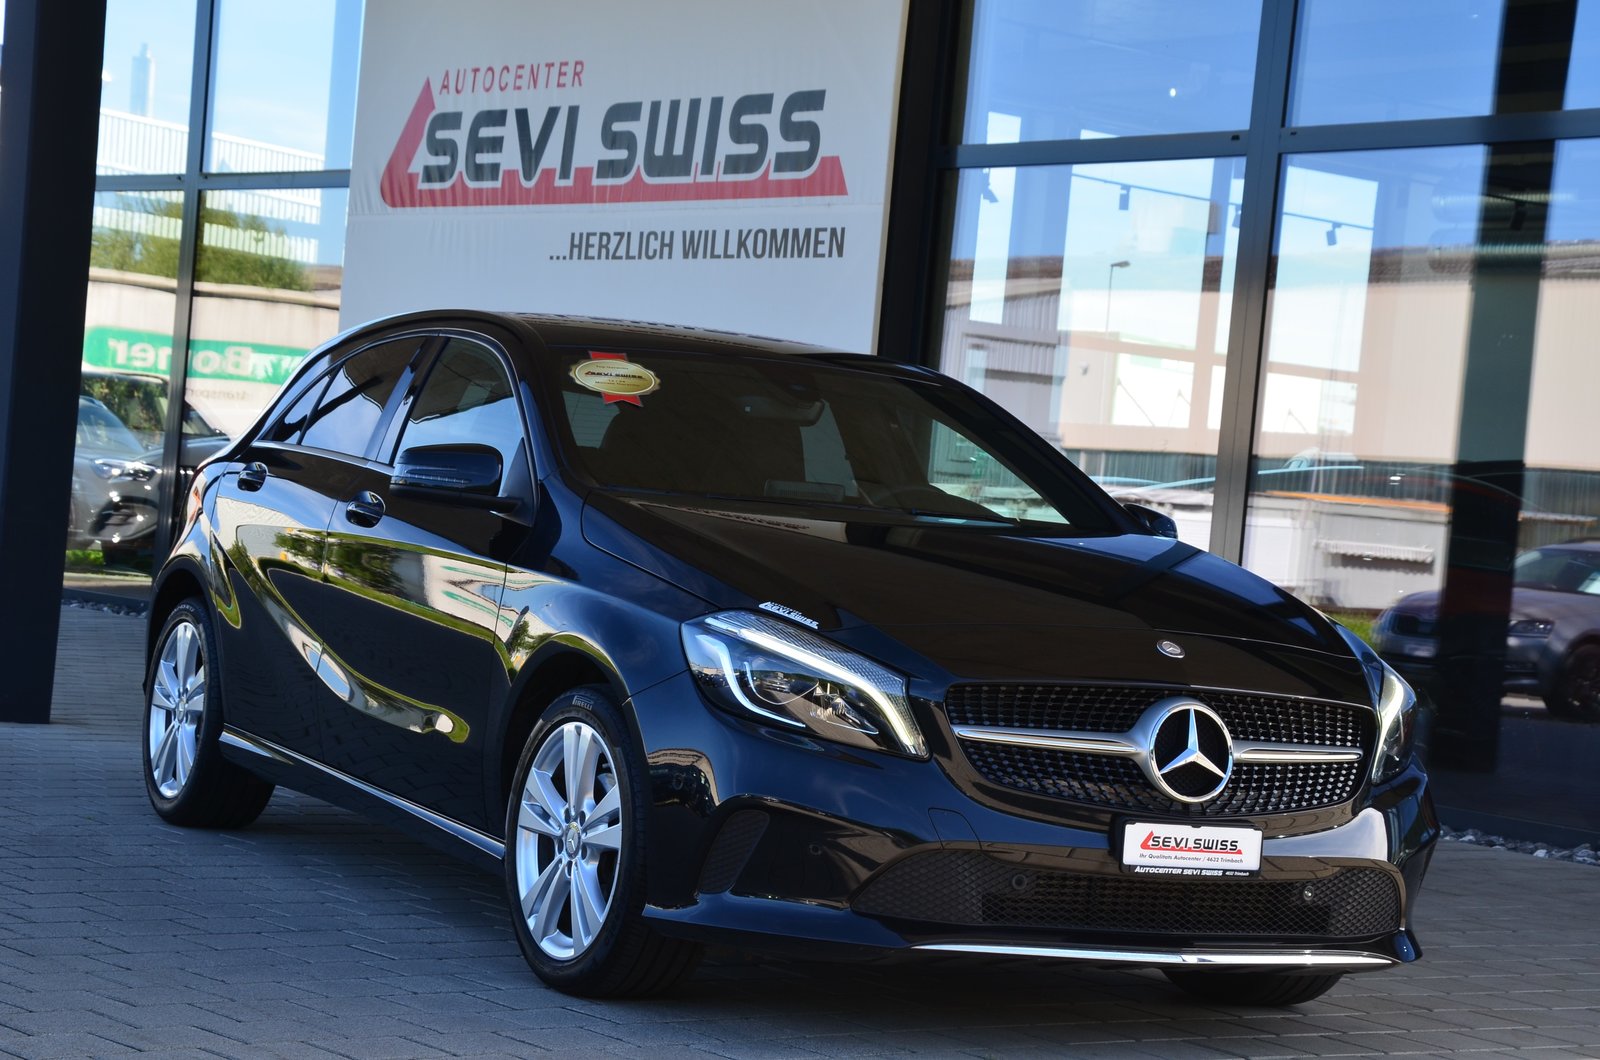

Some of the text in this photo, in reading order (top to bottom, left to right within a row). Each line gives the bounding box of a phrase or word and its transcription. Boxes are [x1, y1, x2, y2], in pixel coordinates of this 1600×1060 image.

[440, 59, 585, 95] AUTOCENTER
[421, 89, 827, 184] SEVI SWISS
[549, 226, 847, 261] ...HERZLICH WILLKOMMEN
[572, 695, 594, 711] PIRELLI
[1151, 836, 1239, 851] SEVI SWISS
[1183, 868, 1200, 876] SEVI
